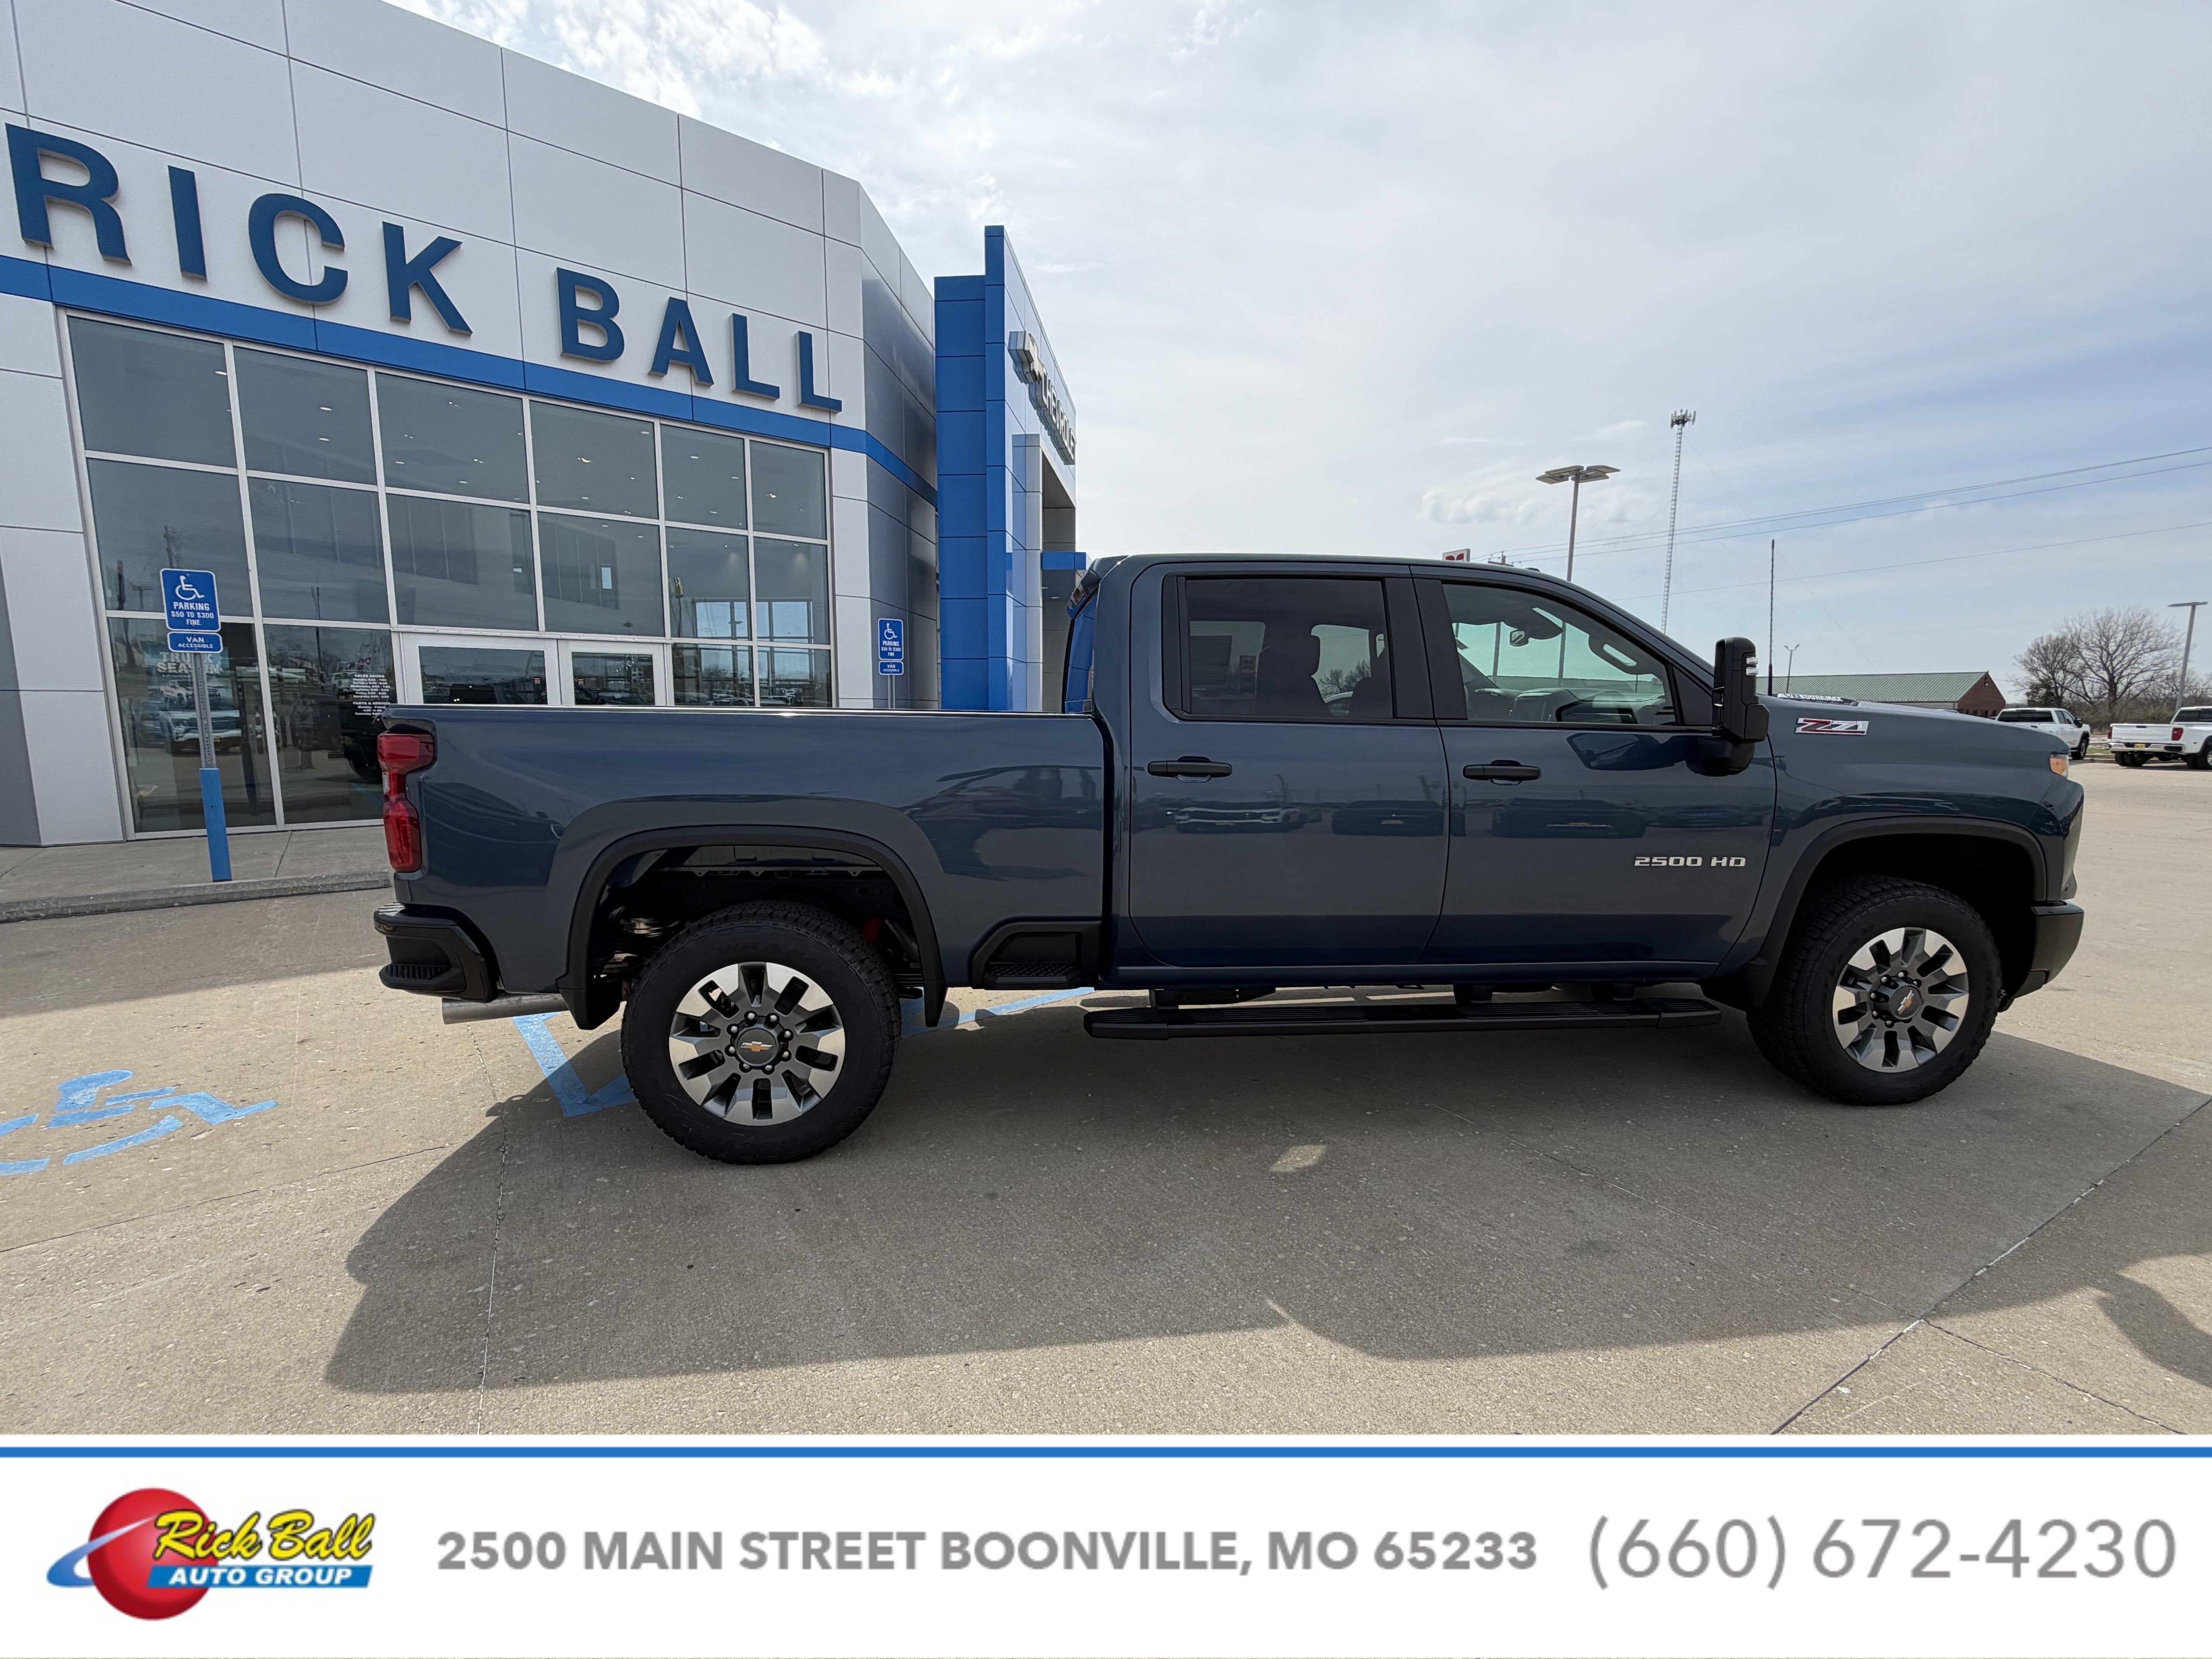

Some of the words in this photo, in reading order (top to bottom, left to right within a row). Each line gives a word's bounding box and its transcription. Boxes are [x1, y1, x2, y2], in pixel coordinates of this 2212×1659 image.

[5, 123, 473, 336] RICK
[554, 267, 842, 414] BALL
[173, 601, 210, 611] PARKING
[1795, 718, 1869, 735] Z71
[1634, 857, 1702, 866] 2500
[1711, 857, 1746, 867] HD
